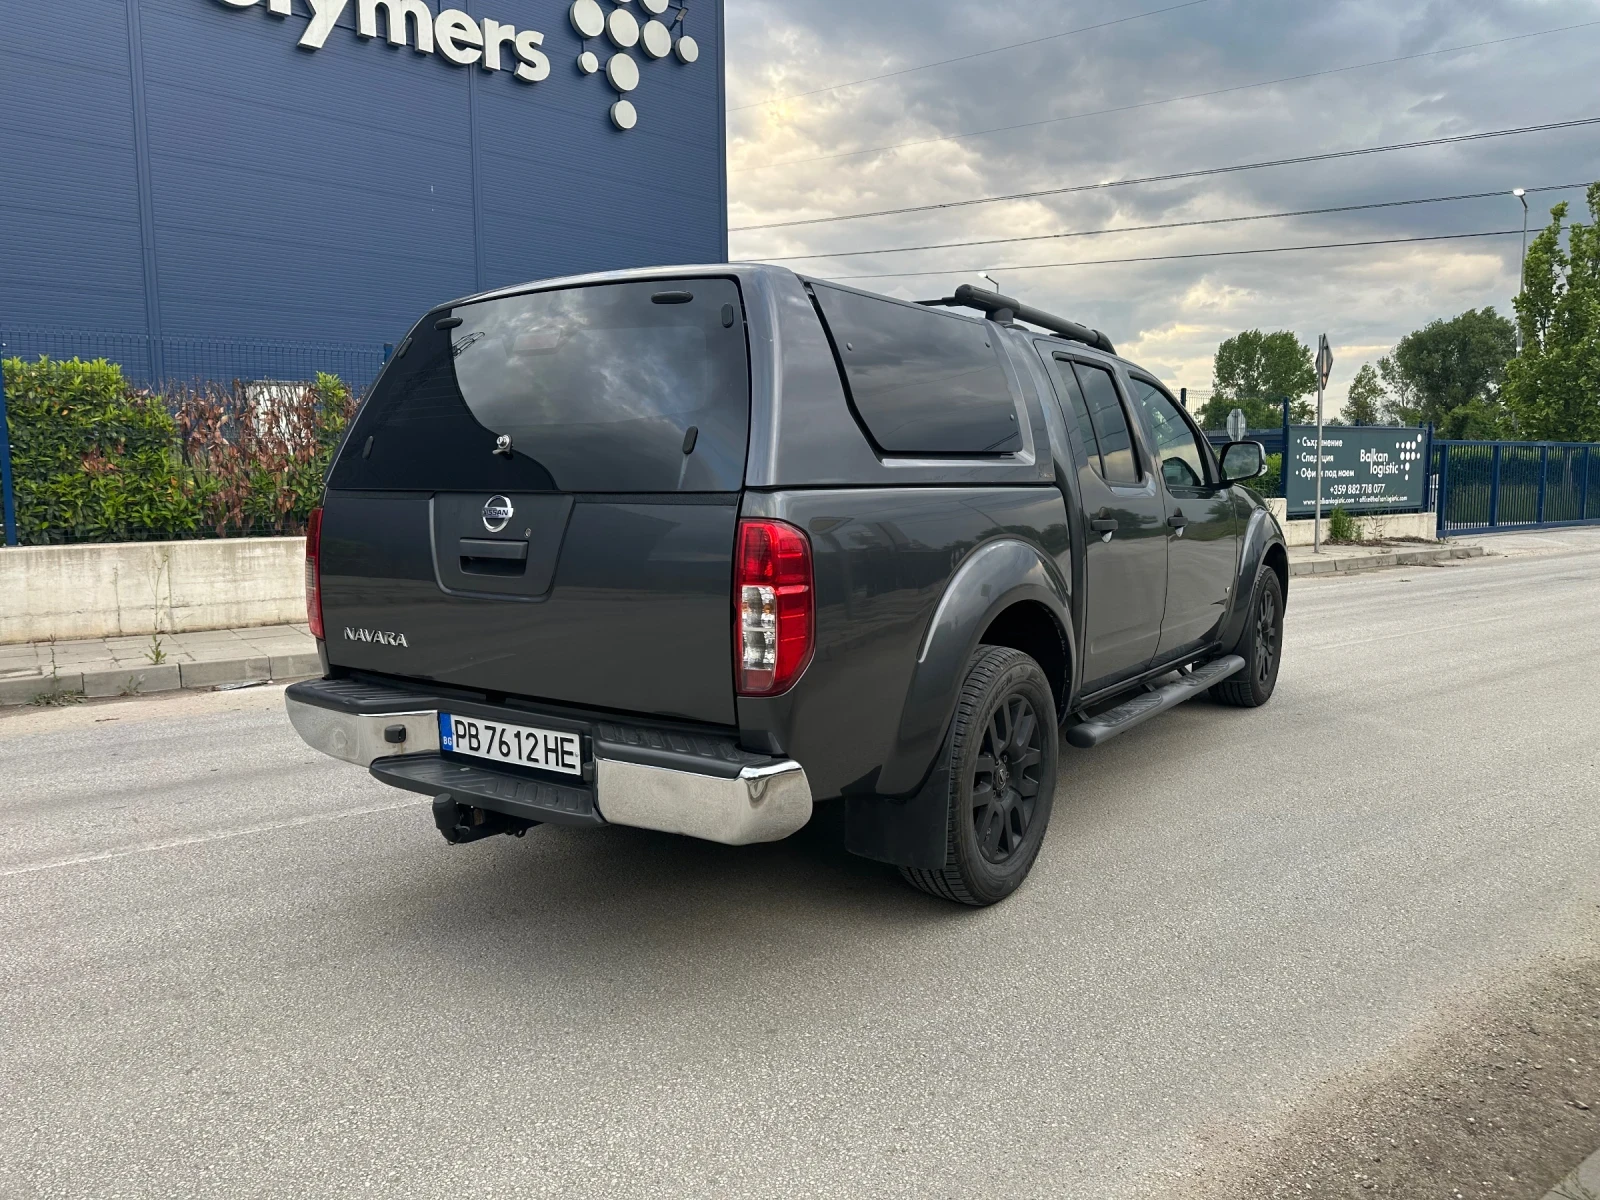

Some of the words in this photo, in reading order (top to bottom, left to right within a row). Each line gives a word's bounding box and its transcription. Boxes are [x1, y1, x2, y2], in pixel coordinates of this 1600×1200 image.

[1360, 448, 1388, 462] Balkan
[1370, 461, 1399, 478] logistic
[1330, 485, 1347, 495] +359
[1347, 484, 1360, 494] 882
[1361, 484, 1372, 494] 718
[1373, 483, 1386, 493] 077
[343, 626, 408, 647] NAVARA
[443, 737, 453, 746] BG
